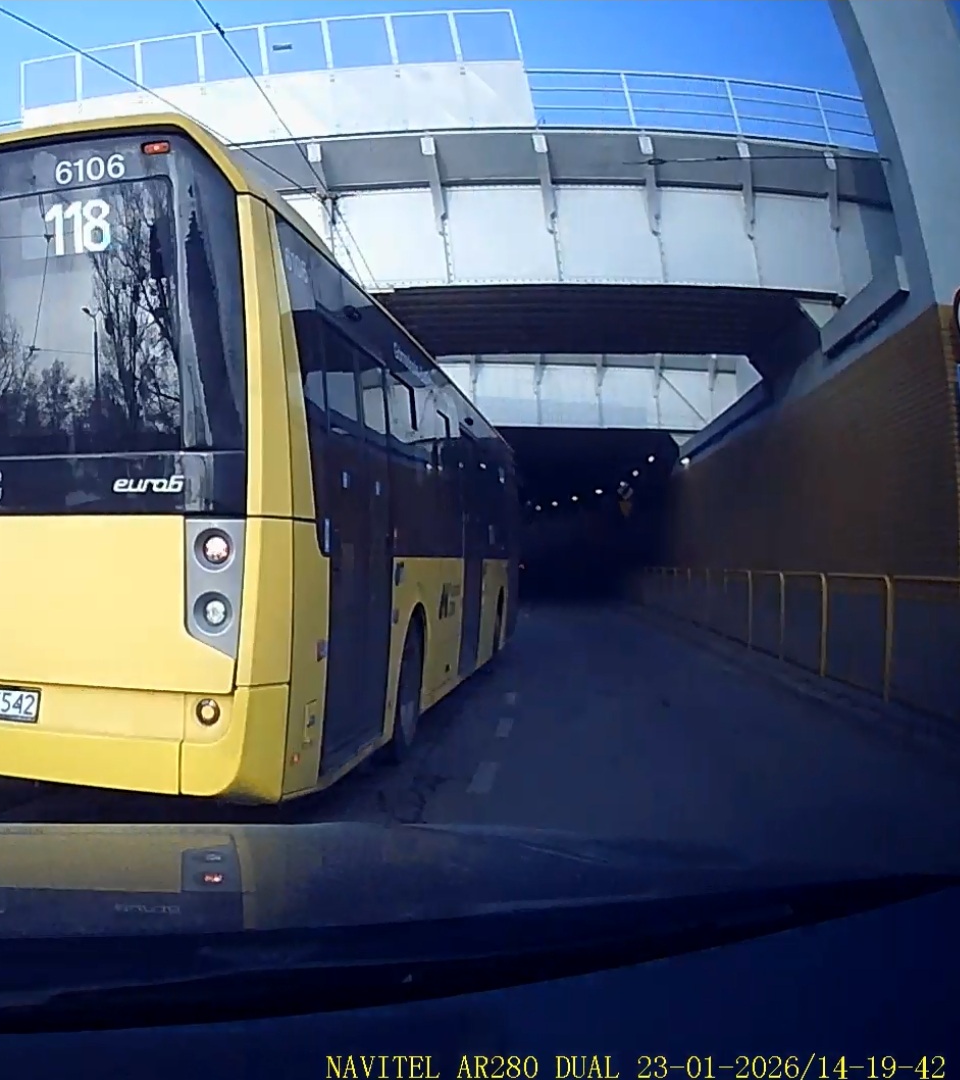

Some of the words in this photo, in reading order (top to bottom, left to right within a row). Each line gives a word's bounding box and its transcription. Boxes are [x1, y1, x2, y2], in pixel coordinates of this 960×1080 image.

[55, 153, 125, 185] 6106
[45, 198, 111, 256] 118
[113, 474, 185, 493] euro6
